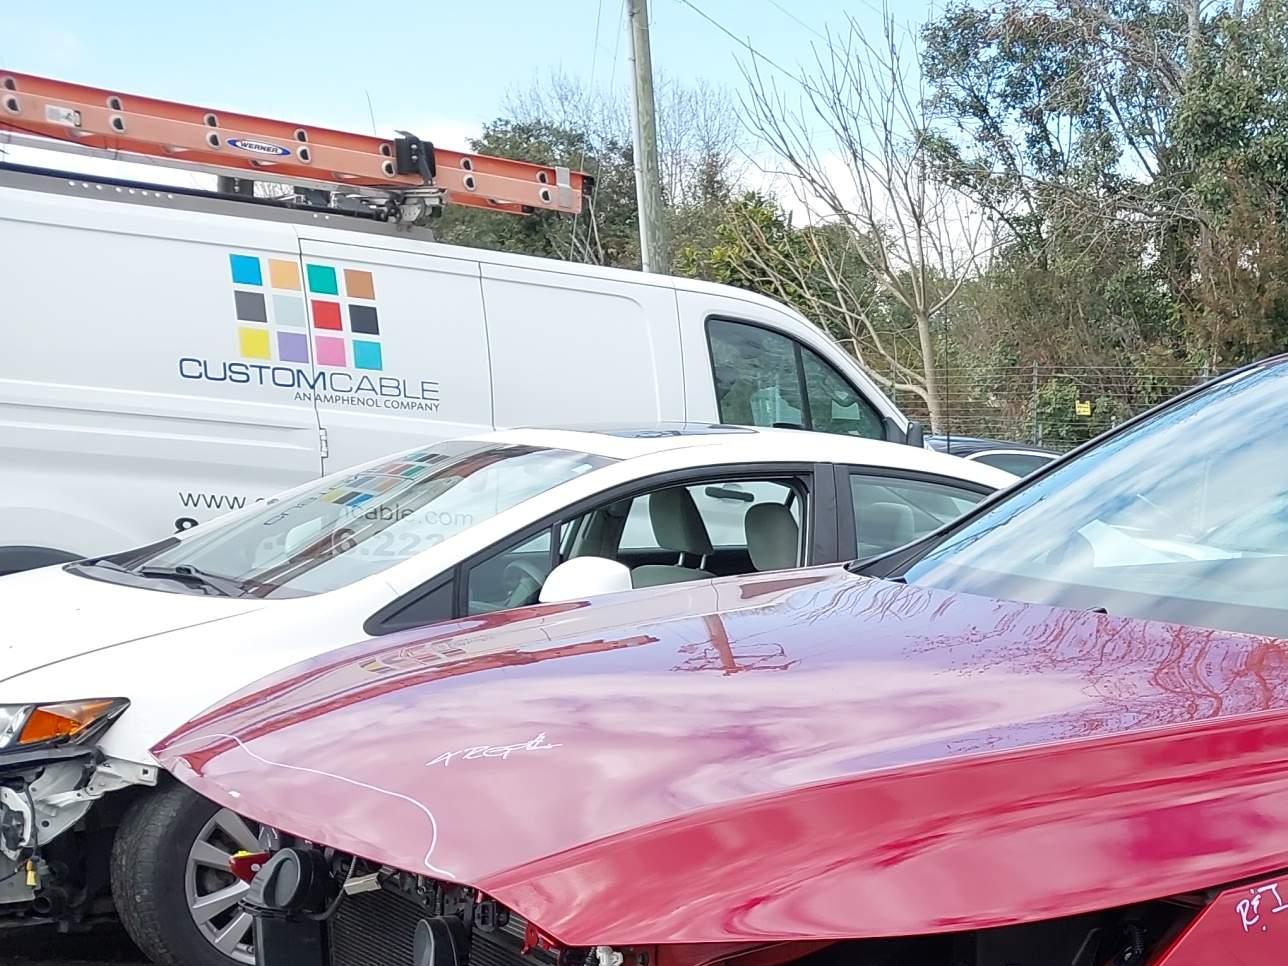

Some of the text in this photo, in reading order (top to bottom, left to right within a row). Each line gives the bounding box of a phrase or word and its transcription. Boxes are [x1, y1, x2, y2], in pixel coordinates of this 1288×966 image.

[240, 142, 279, 153] WERNER
[179, 358, 440, 401] CUSTOMCABLE
[294, 391, 440, 412] AN AMPHENOL COMPANY
